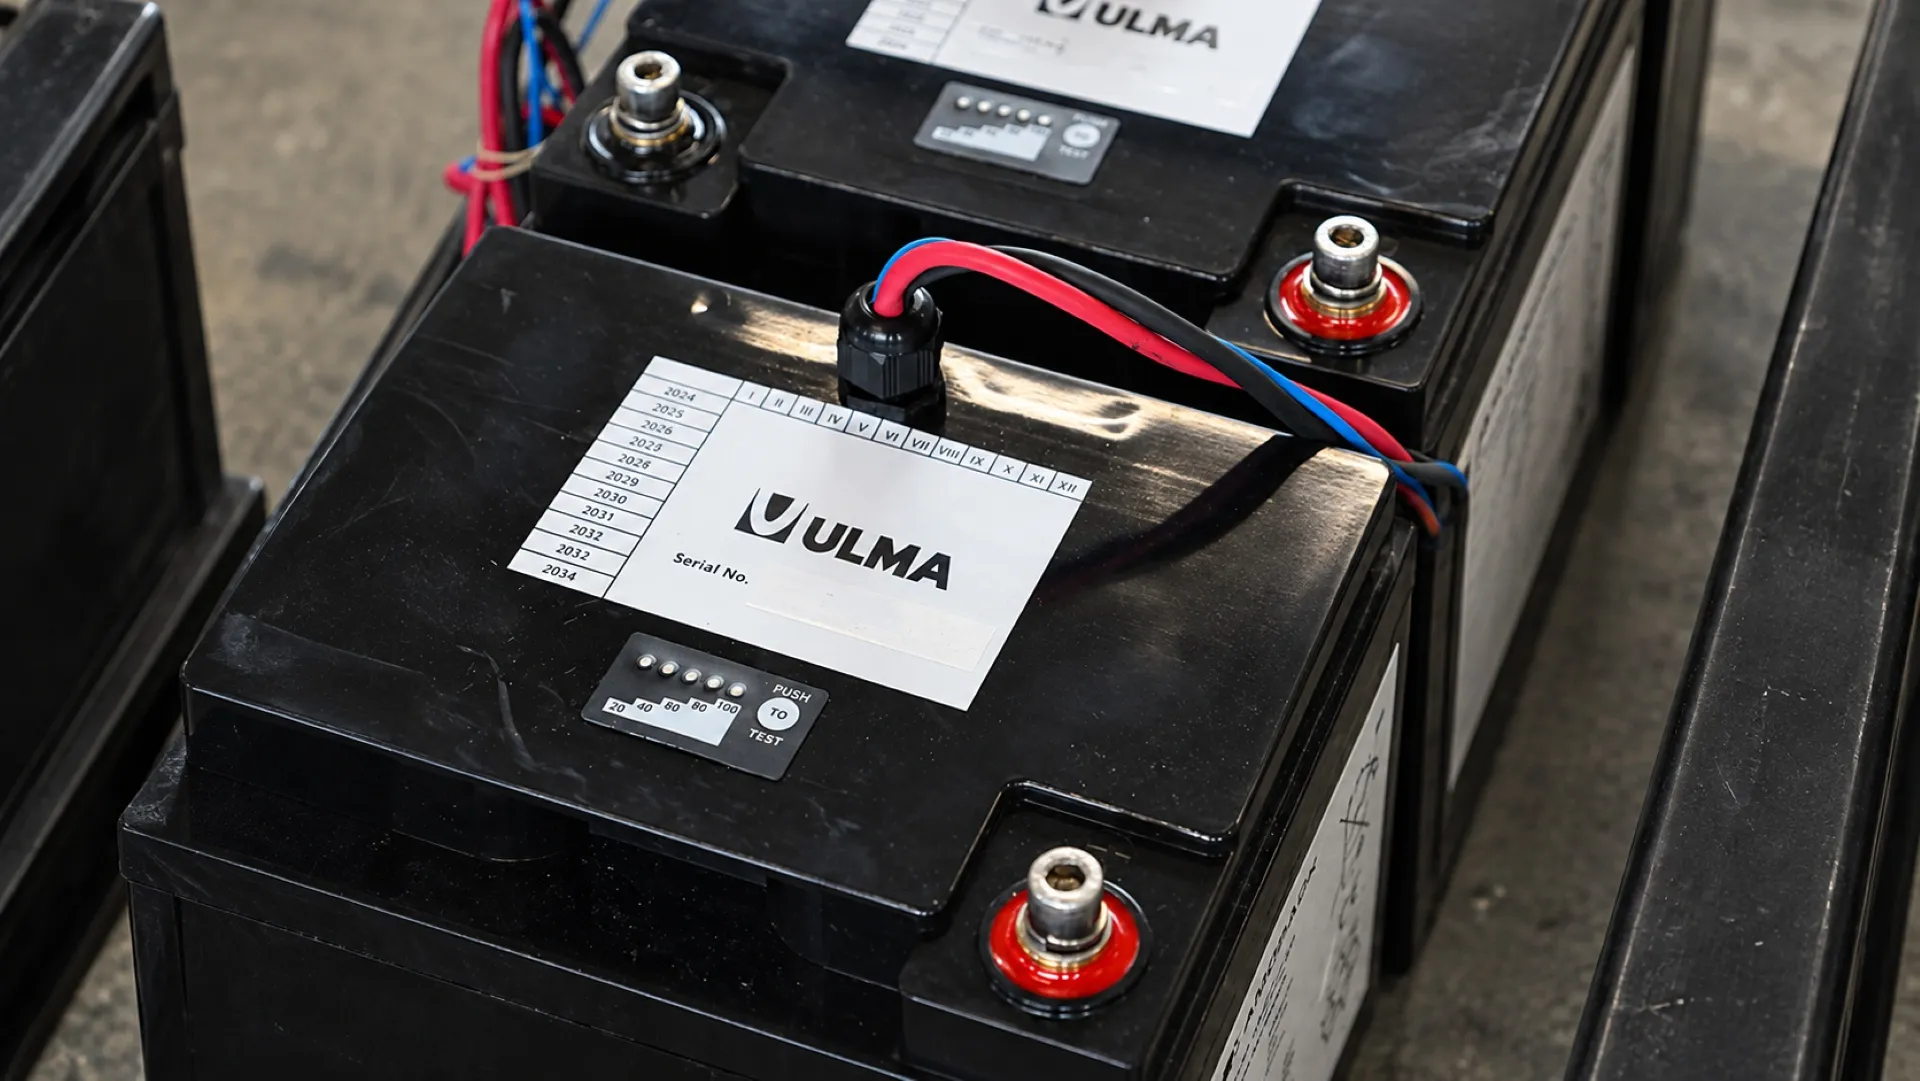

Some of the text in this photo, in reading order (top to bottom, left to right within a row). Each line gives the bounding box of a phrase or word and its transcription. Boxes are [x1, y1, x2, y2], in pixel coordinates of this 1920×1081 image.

[1095, 2, 1218, 49] ULMA
[664, 386, 697, 402] 2024
[652, 403, 685, 419] 2025
[641, 419, 673, 436] 2026
[774, 398, 784, 408] II
[800, 405, 814, 416] III
[827, 413, 844, 425] IV
[859, 422, 870, 432] V
[886, 431, 900, 442] VI
[911, 438, 931, 451] VII
[939, 446, 961, 460] VIII
[969, 455, 985, 466] IX
[1003, 464, 1014, 474] X
[1029, 473, 1044, 484] XI
[1058, 480, 1078, 494] XII
[605, 470, 640, 487] 2029
[593, 488, 628, 504] 2030
[582, 505, 614, 522] 2031
[569, 524, 604, 542] 2032
[556, 544, 590, 561] 2032
[802, 516, 951, 591] ULMA
[542, 564, 578, 582] 2034
[673, 552, 749, 585] Serial No.
[772, 684, 811, 703] PUSH
[609, 701, 626, 713] 20
[636, 702, 653, 713] 40
[691, 701, 708, 713] 80
[716, 701, 739, 714] 100
[770, 707, 788, 720] TO
[748, 728, 784, 747] TEST
